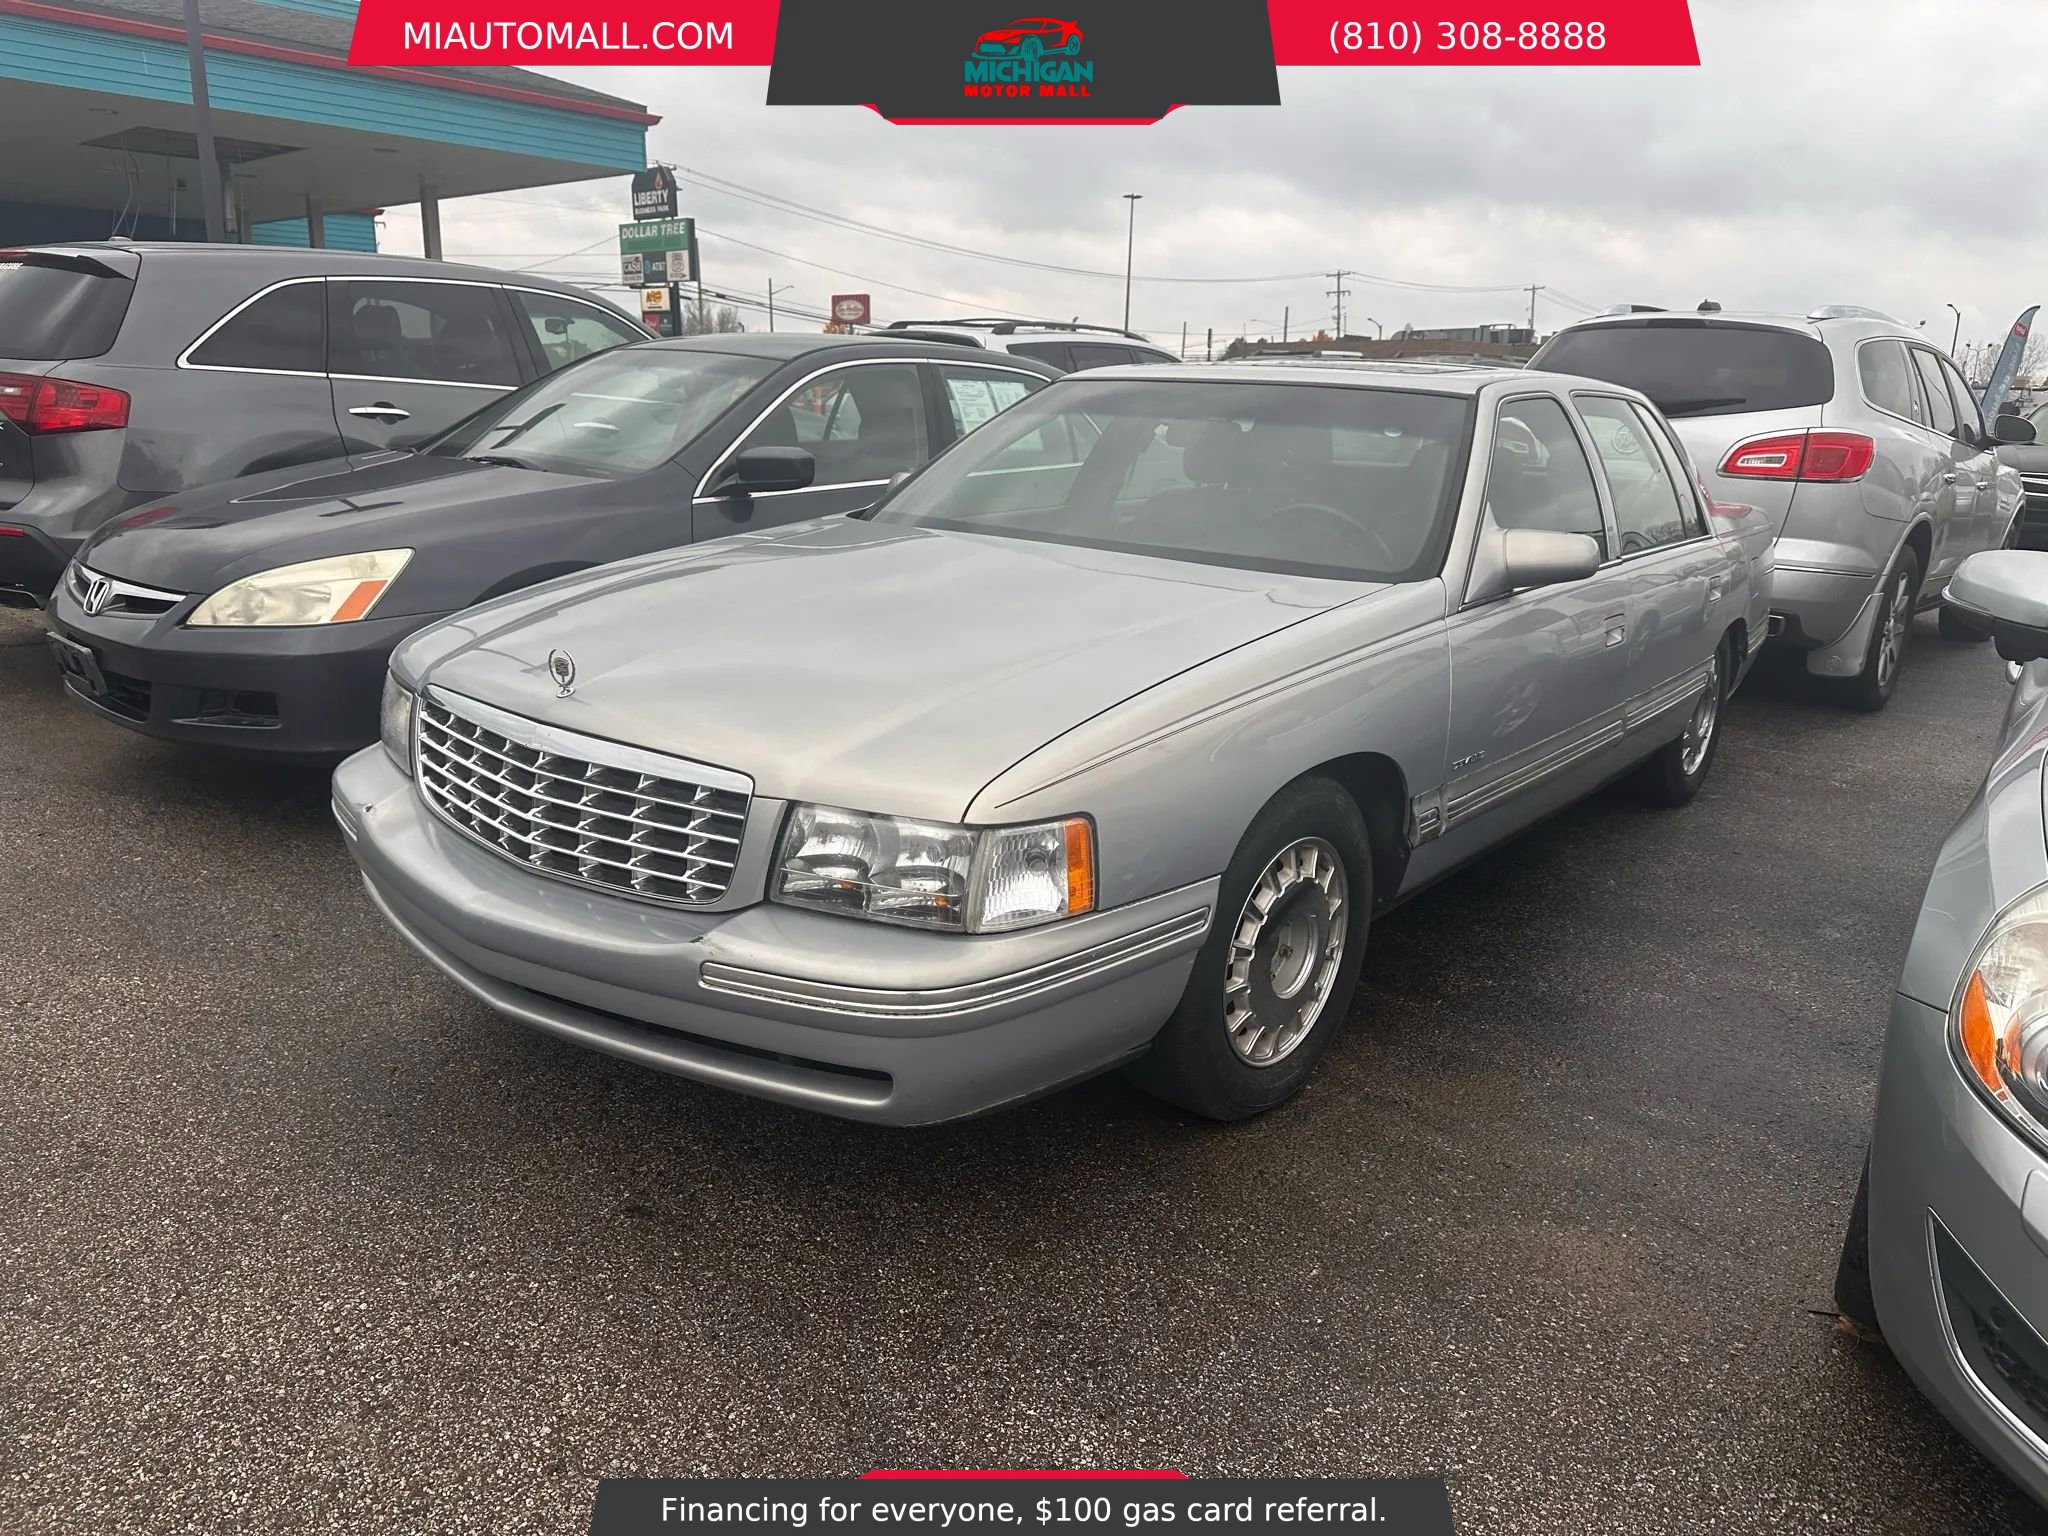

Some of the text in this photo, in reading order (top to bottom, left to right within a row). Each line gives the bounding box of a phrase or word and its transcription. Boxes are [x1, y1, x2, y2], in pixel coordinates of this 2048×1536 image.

[634, 189, 668, 206] LIBERTY
[622, 222, 686, 239] DOLLAR TREE
